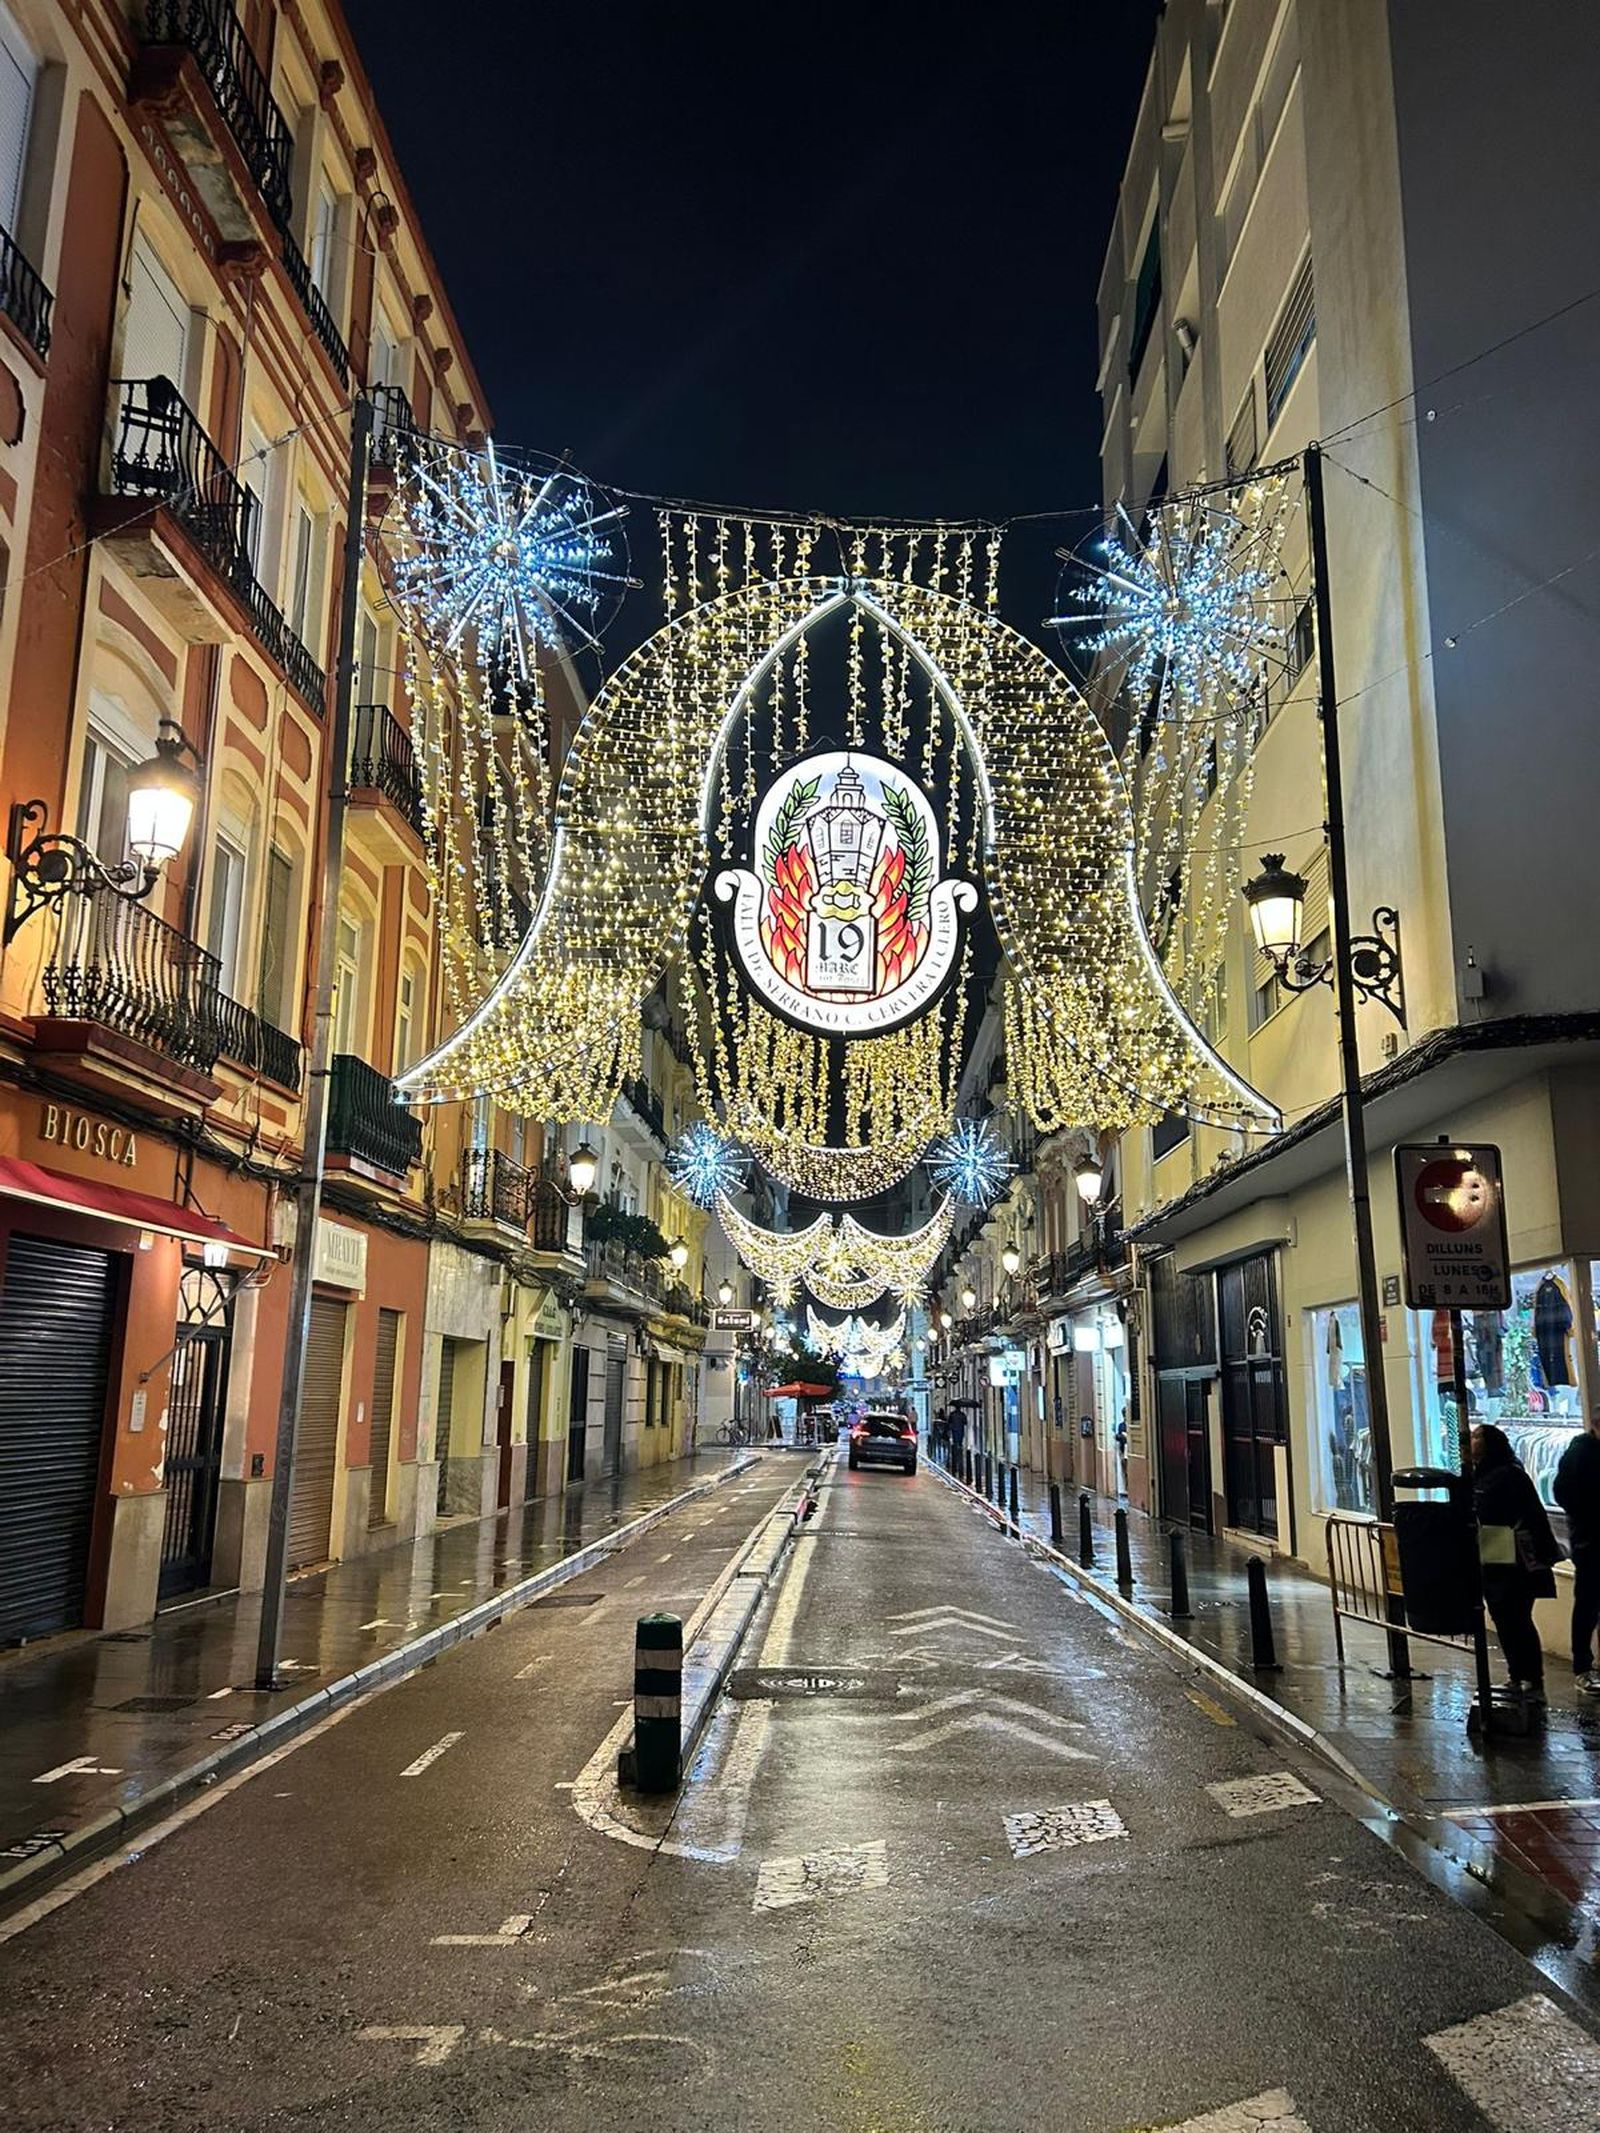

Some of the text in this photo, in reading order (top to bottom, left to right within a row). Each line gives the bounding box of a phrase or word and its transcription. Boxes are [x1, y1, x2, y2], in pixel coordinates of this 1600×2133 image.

[818, 922, 864, 962] 19
[763, 978, 838, 1023] SERRANO
[868, 973, 936, 1022] CERVERA
[45, 1104, 137, 1166] BIOSCA
[1426, 1243, 1484, 1254] DILLUNS
[1434, 1265, 1480, 1276] LUNES
[1418, 1284, 1436, 1295] DE
[1459, 1284, 1468, 1295] A
